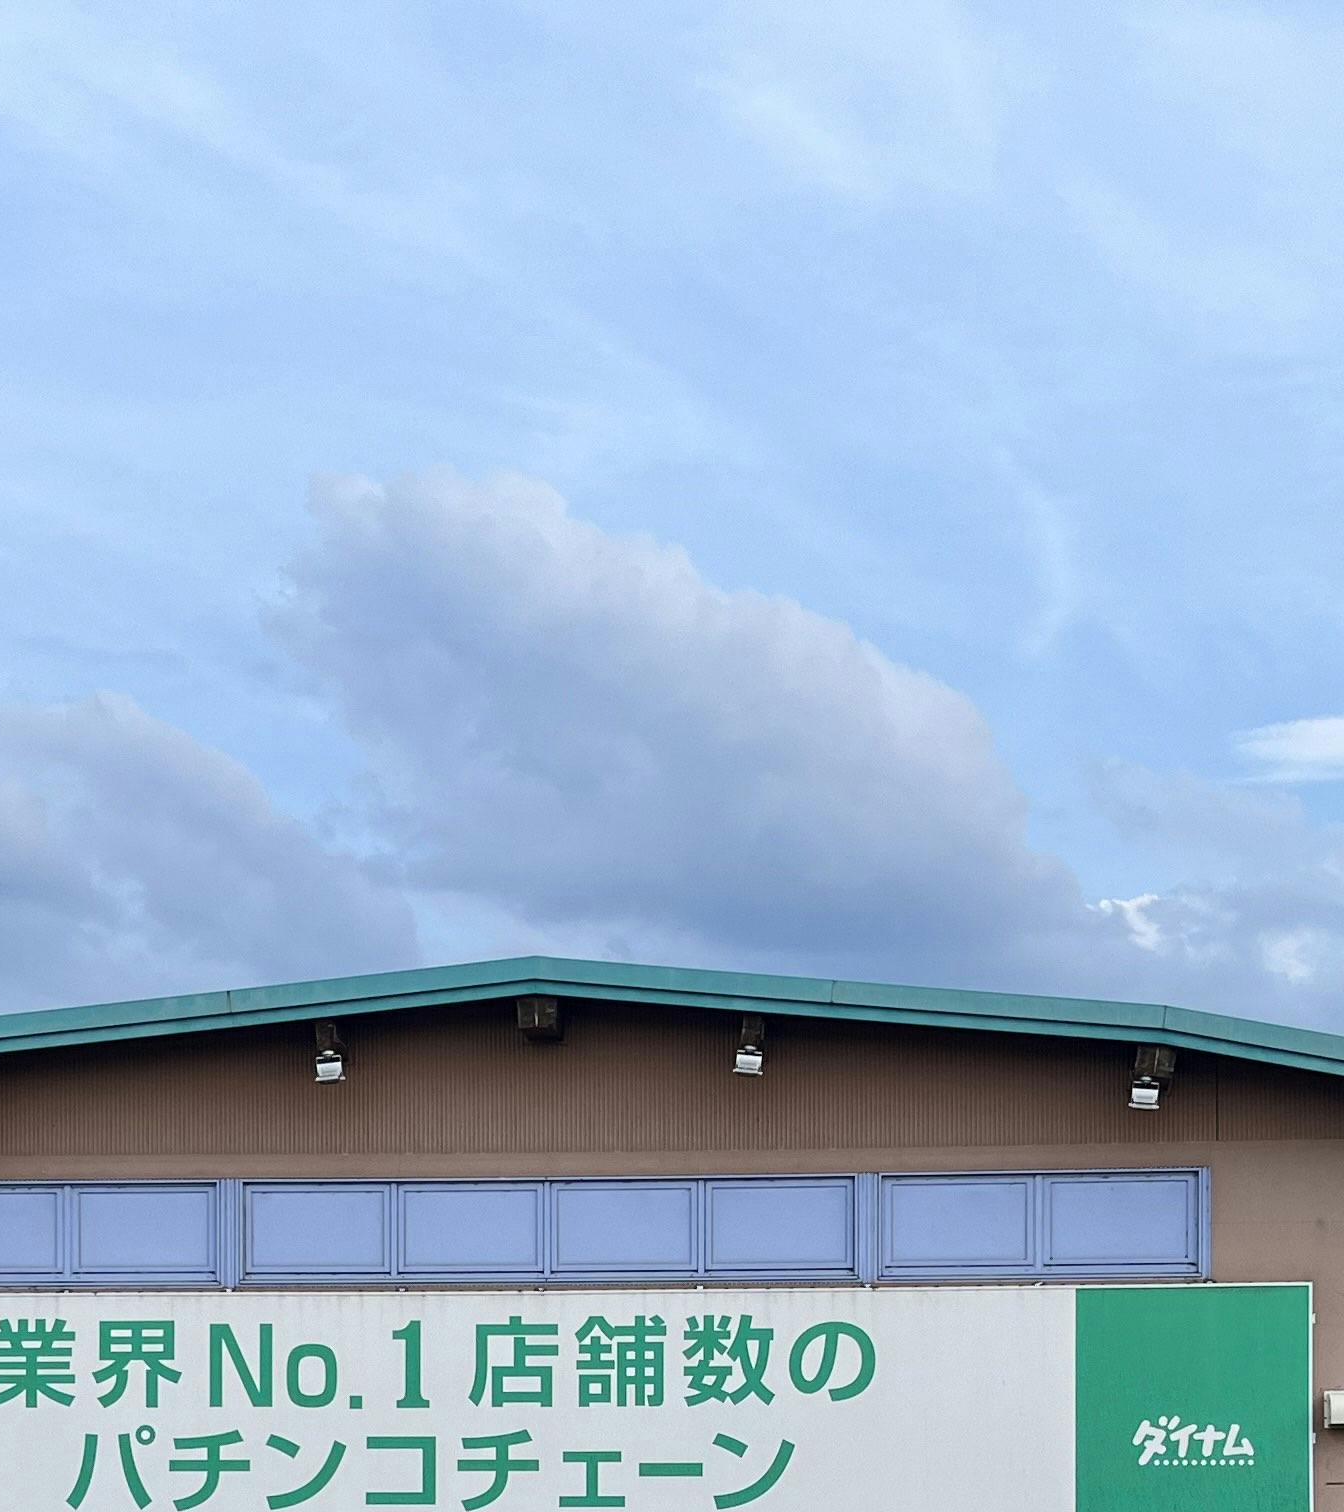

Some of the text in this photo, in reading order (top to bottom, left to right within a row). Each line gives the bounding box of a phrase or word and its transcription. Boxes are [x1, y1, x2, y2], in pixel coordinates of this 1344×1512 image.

[68, 1424, 795, 1511] パチンコチェーン
[1133, 1416, 1254, 1465] ダイナム
